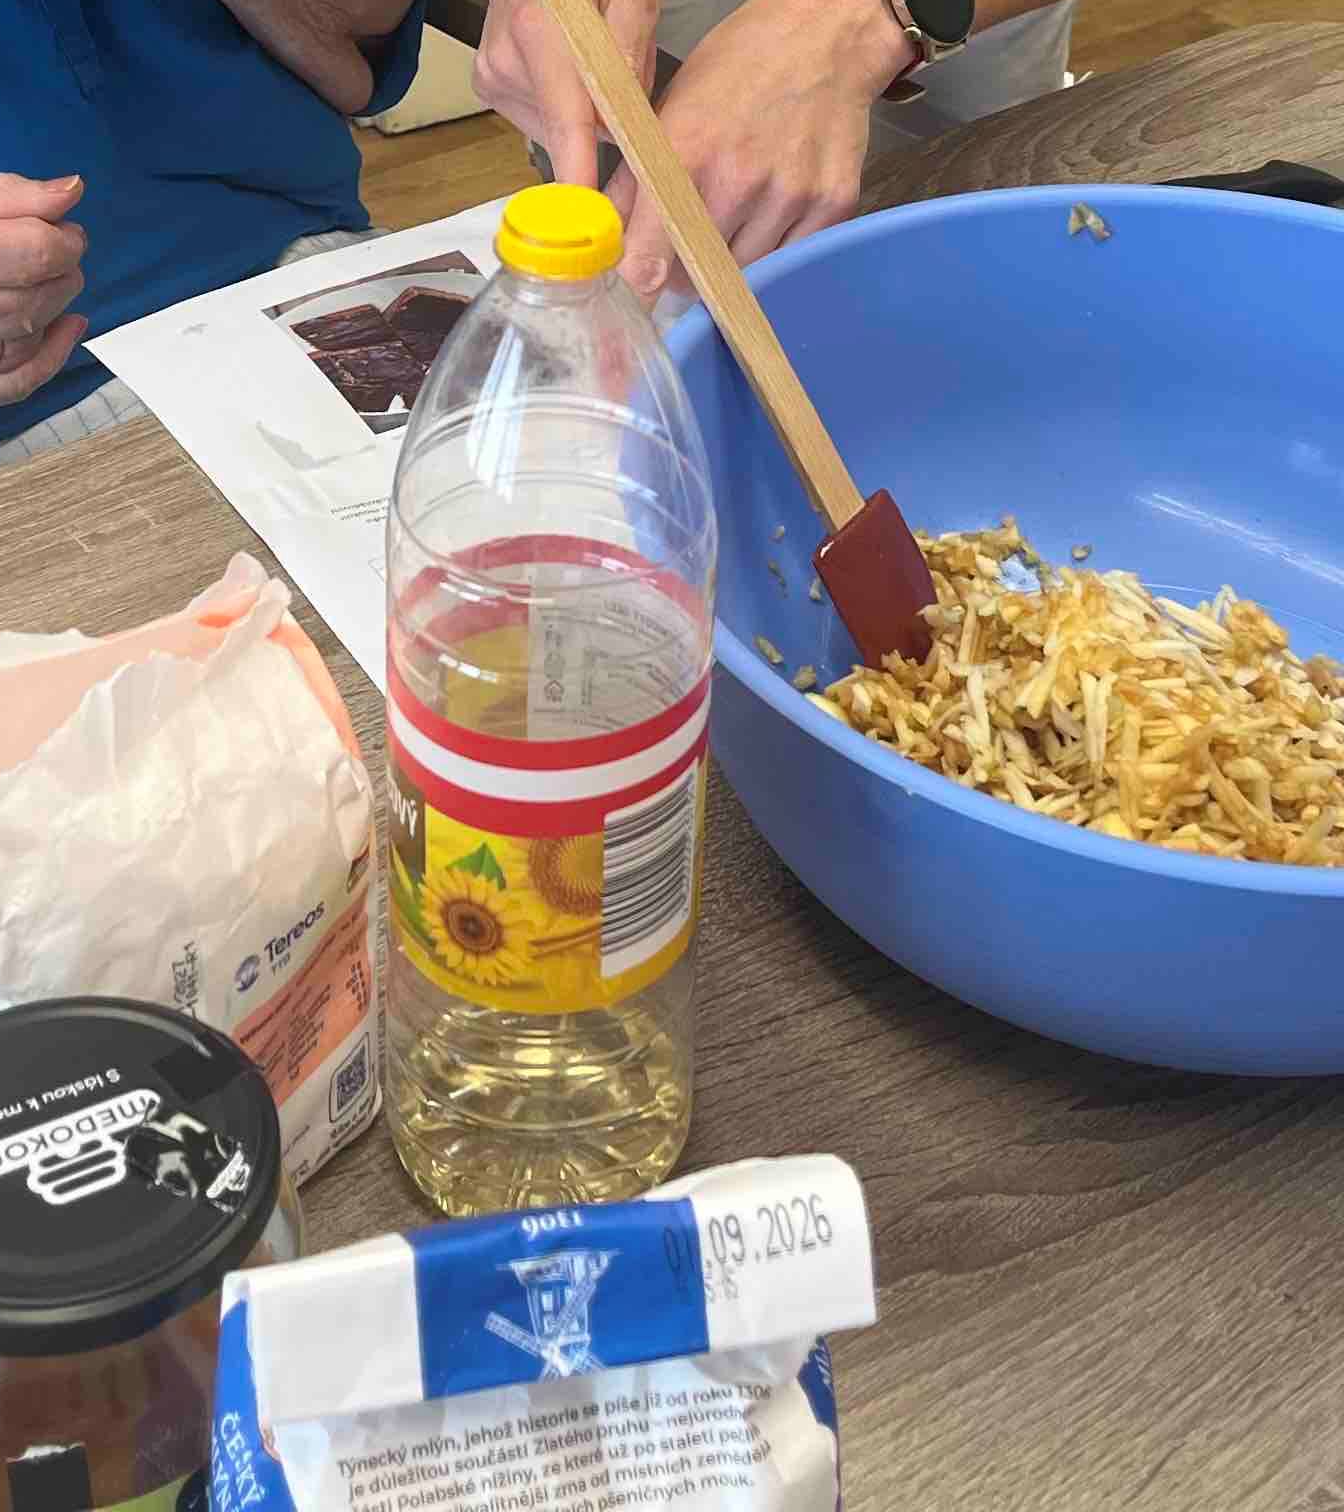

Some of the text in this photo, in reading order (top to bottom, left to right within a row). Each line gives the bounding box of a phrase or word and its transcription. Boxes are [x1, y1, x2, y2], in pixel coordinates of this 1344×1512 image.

[264, 901, 325, 962] Tereos
[42, 1073, 104, 1103] láskou
[106, 1068, 121, 1083] S
[26, 1097, 40, 1111] k
[337, 1442, 408, 1479] Týnecký
[412, 1434, 461, 1459] mlýn,
[464, 1420, 513, 1451] jehož
[518, 1408, 579, 1435] historie
[582, 1402, 600, 1418] se
[605, 1394, 641, 1416] píše
[645, 1392, 661, 1412] již
[666, 1391, 688, 1407] od
[693, 1387, 733, 1404] roku
[348, 1480, 365, 1504] je
[369, 1462, 449, 1495] důležitou
[455, 1442, 529, 1473] součástí
[533, 1427, 593, 1455] Zlatého
[596, 1419, 650, 1445] pruhu
[398, 1478, 476, 1512] Polabské
[481, 1467, 538, 1493] nížiny,
[543, 1463, 561, 1478] ze
[564, 1447, 604, 1473] které
[608, 1442, 626, 1459] už
[633, 1441, 656, 1460] po
[659, 1428, 714, 1450] staletí
[590, 1468, 610, 1489] od
[615, 1455, 692, 1481] místních
